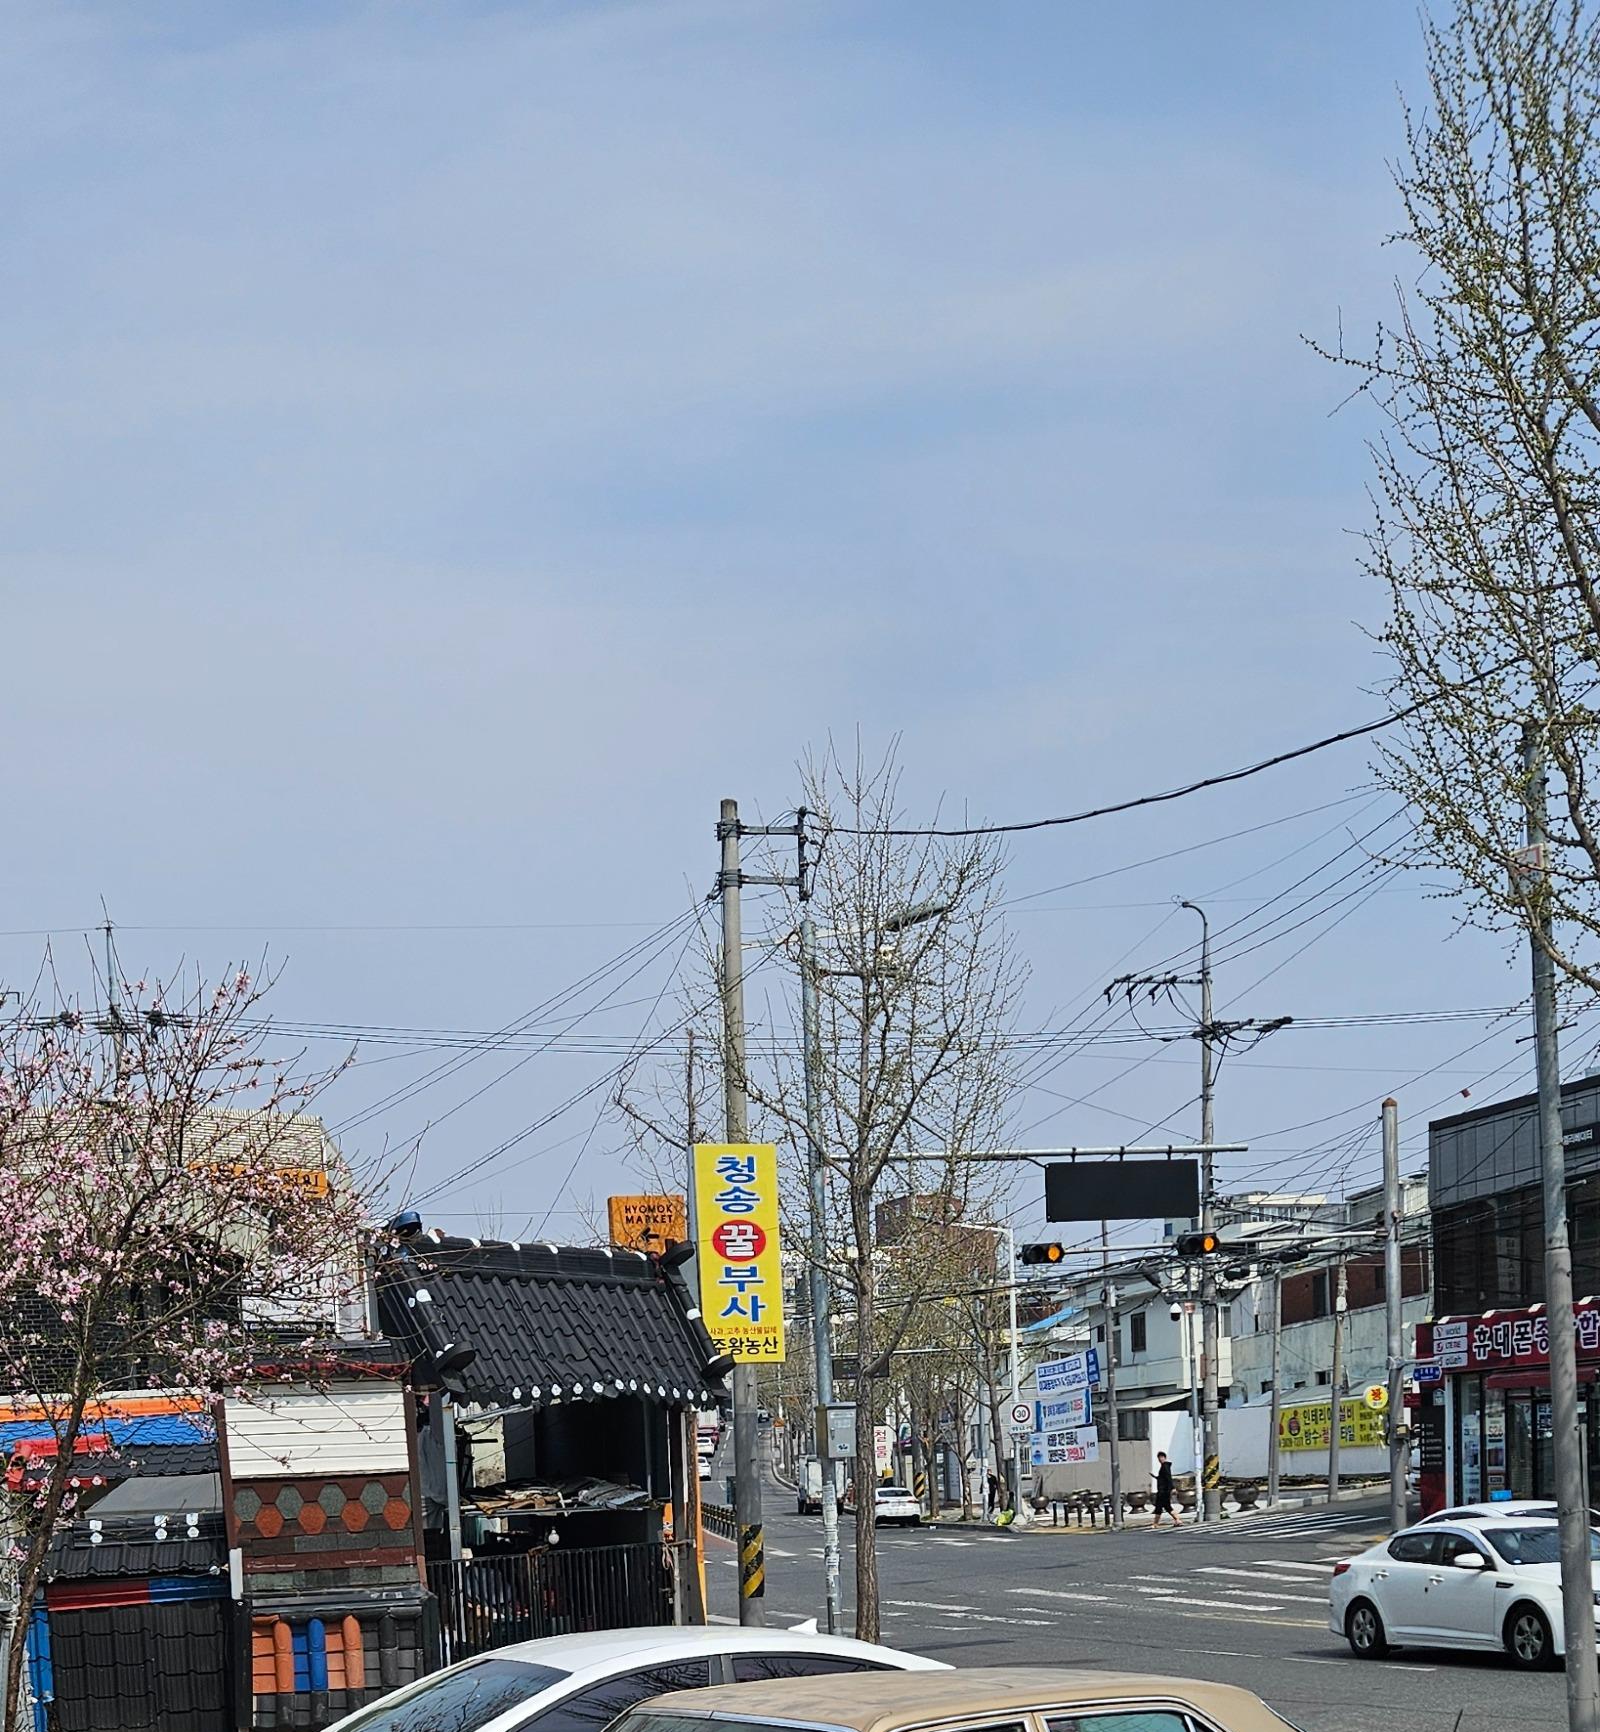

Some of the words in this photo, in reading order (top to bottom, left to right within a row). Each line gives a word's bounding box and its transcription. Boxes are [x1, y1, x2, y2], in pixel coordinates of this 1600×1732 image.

[715, 1156, 760, 1213] 청송
[624, 1204, 673, 1214] HYOMOK
[625, 1214, 673, 1224] MARKET
[719, 1225, 759, 1257] 꿀
[718, 1266, 766, 1322] 부사
[712, 1336, 779, 1355] 주왕농산
[1016, 1410, 1027, 1419] 30
